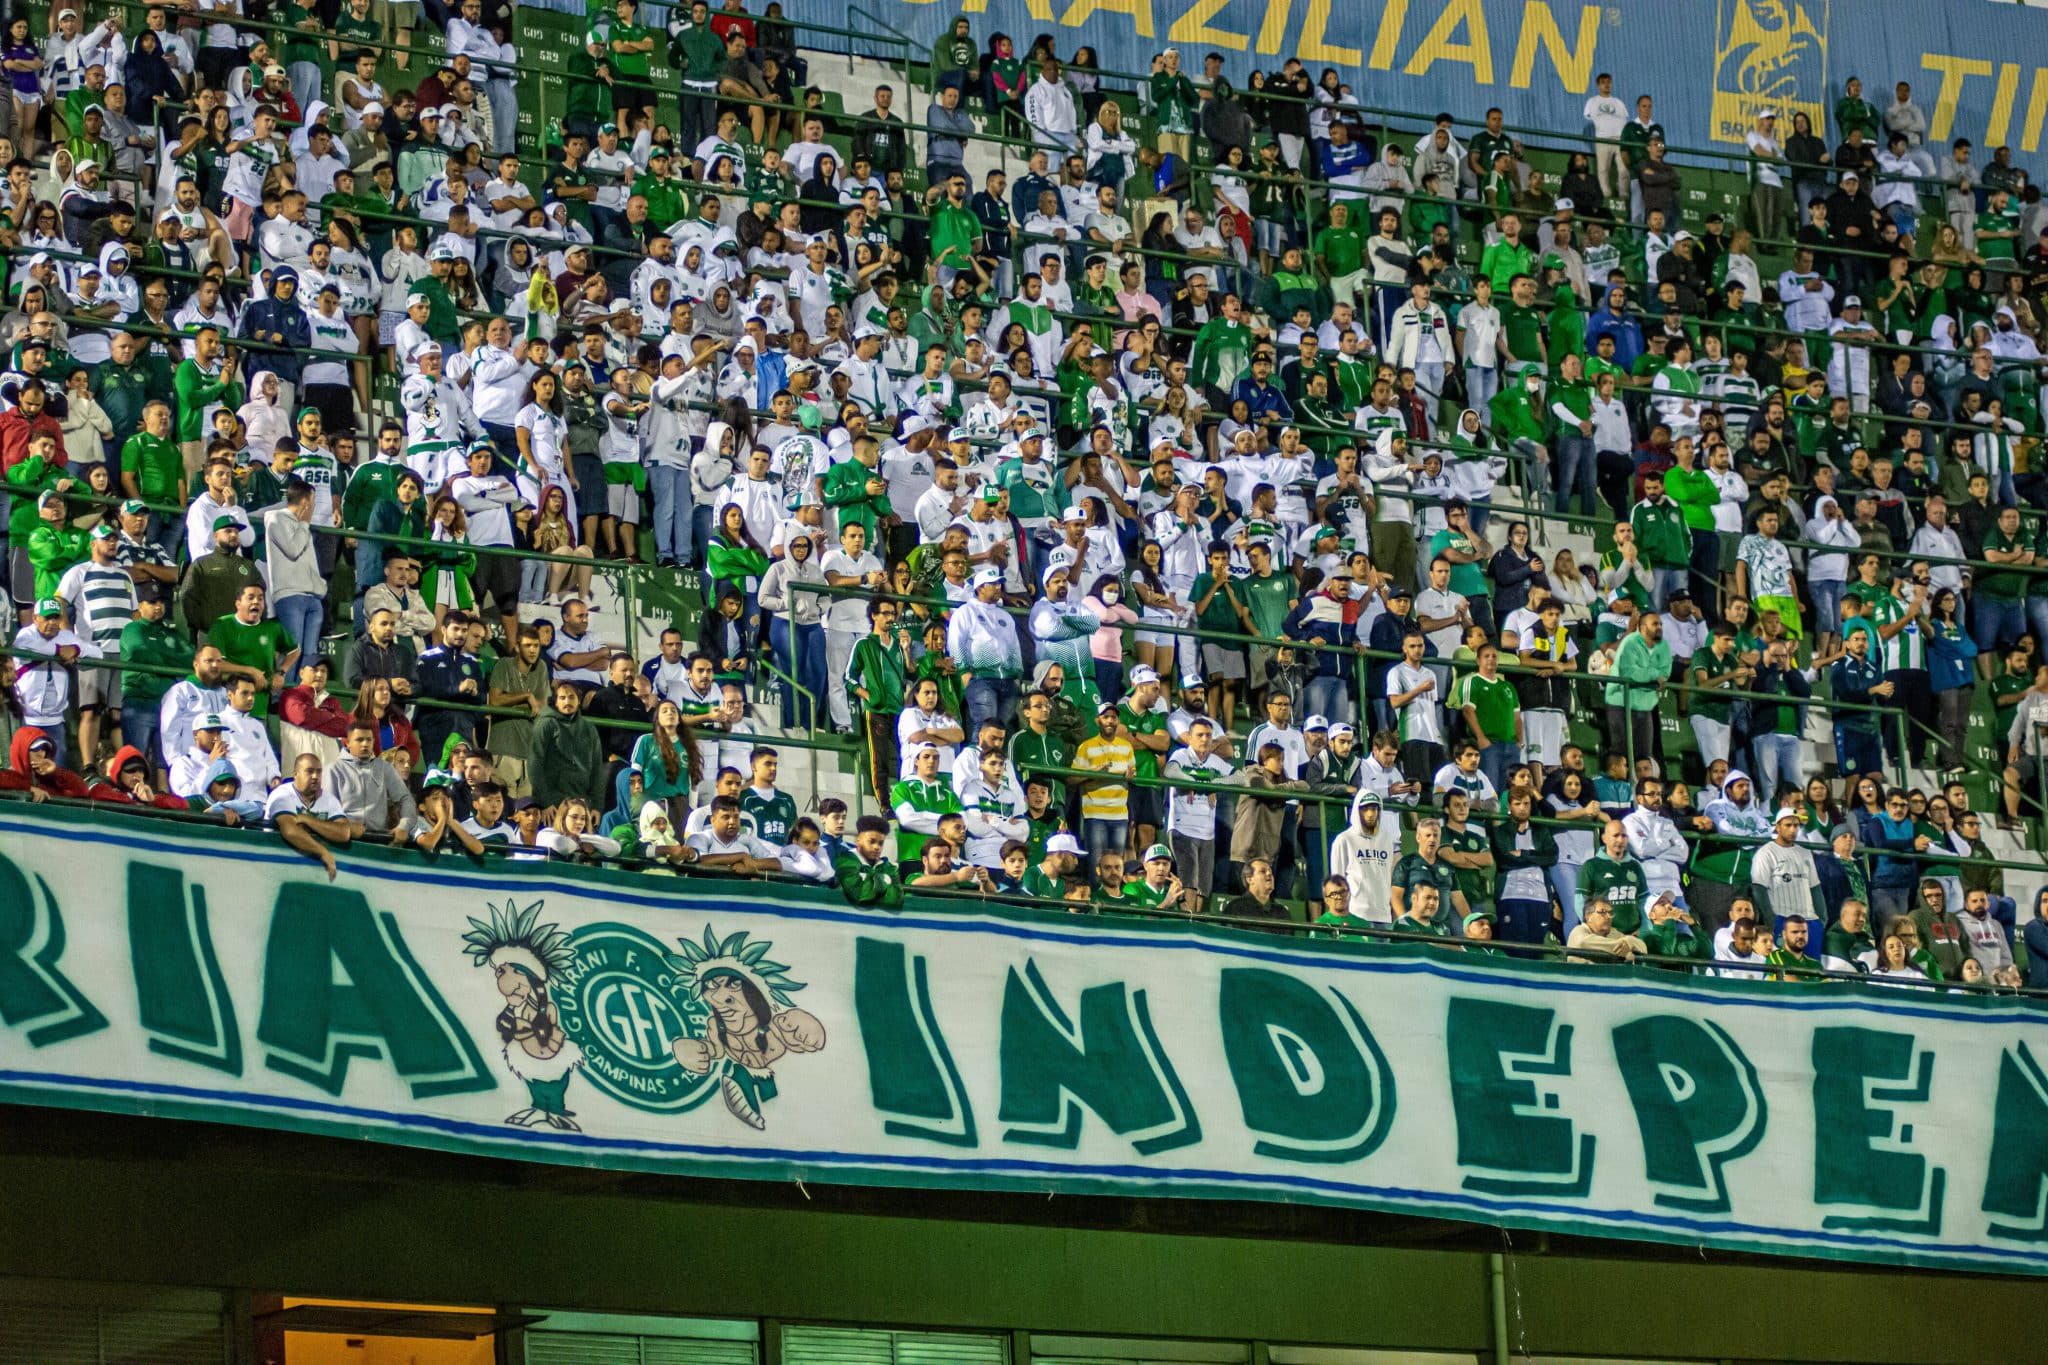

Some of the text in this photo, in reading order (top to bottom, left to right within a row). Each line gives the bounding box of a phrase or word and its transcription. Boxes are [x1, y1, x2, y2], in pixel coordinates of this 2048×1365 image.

[214, 156, 229, 168] as
[305, 470, 329, 483] asa
[674, 572, 700, 590] 225
[652, 606, 673, 624] 198
[764, 821, 785, 834] asa
[1608, 885, 1637, 900] asa
[560, 949, 608, 1032] GUARANI
[596, 983, 672, 1059] GFC
[585, 1044, 667, 1095] CAMPINAS
